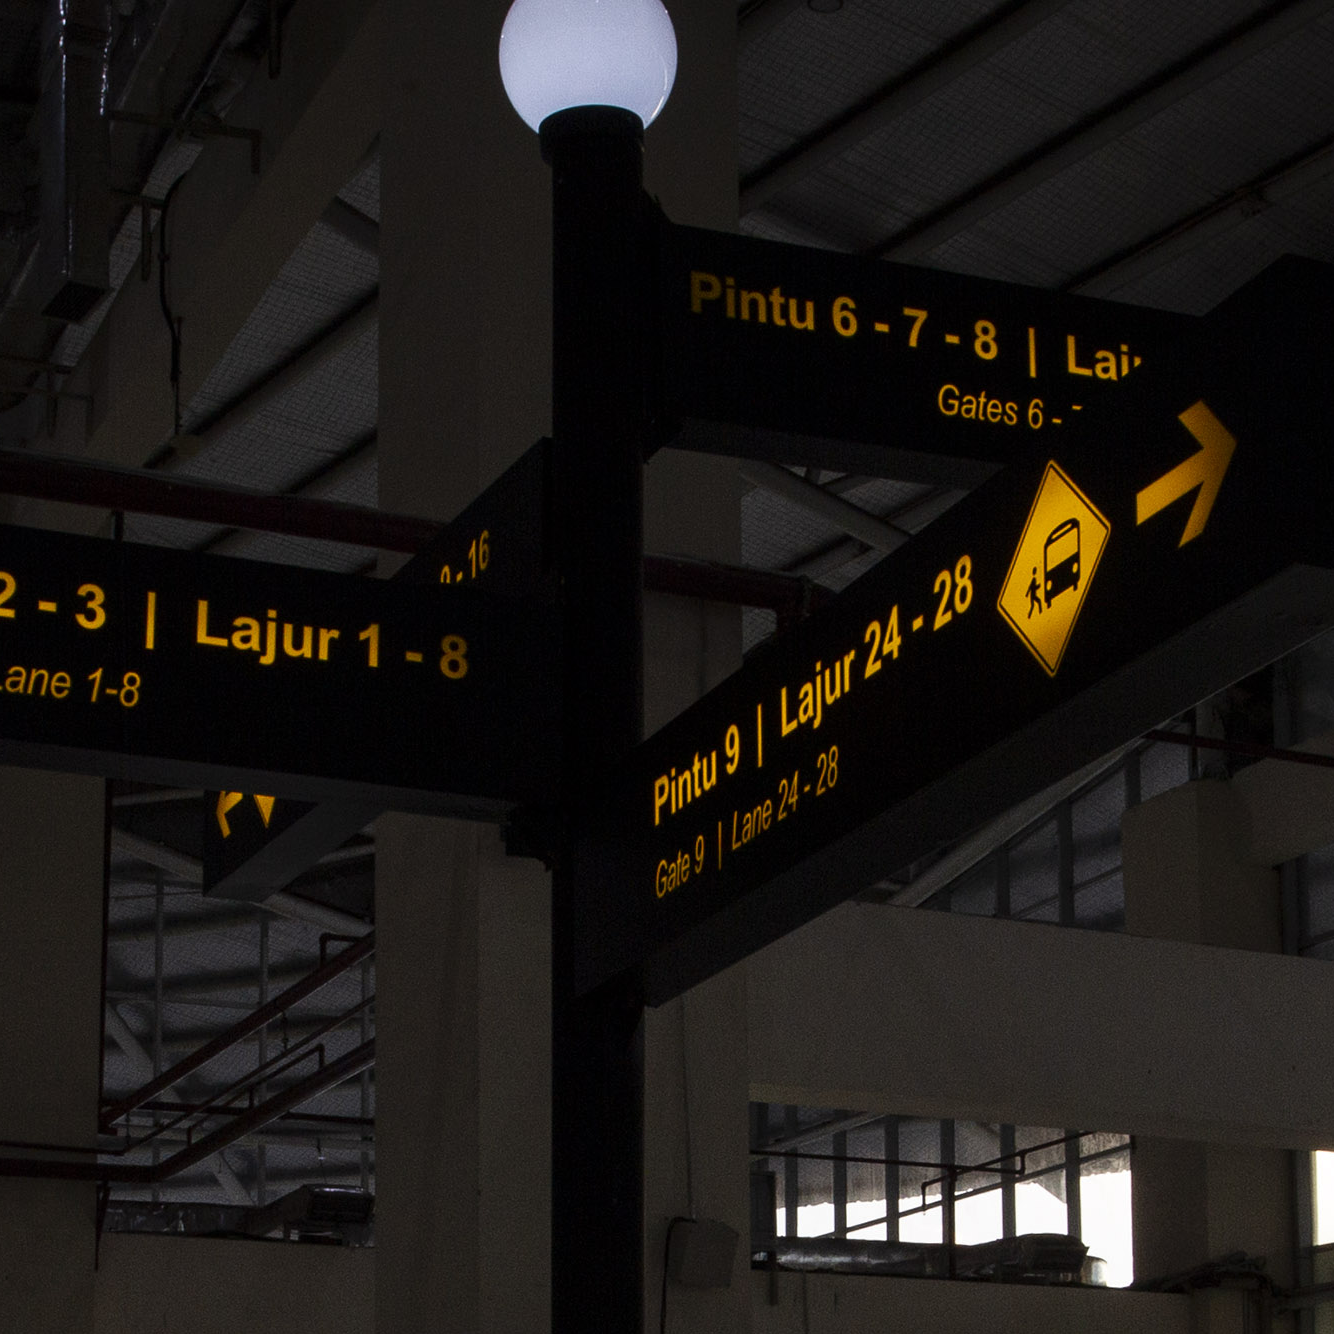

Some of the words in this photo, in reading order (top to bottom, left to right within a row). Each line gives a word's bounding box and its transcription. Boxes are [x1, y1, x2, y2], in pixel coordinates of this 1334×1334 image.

[689, 270, 815, 331] Pintu
[832, 296, 858, 337] 6
[903, 307, 928, 348] 7
[973, 319, 998, 361] 8
[937, 383, 1019, 426] Gates
[1027, 398, 1044, 430] 6
[468, 530, 489, 579] 16
[74, 583, 106, 630] 3
[196, 599, 340, 666] Lajur
[359, 623, 379, 668] 1
[440, 638, 468, 679] 8
[87, 667, 141, 707] 1-8
[654, 749, 717, 826] Pintu
[724, 723, 740, 775] 9
[780, 648, 856, 737] Lajur
[863, 604, 902, 680] 24
[932, 554, 974, 632] 28
[655, 850, 690, 898] Gate
[694, 834, 705, 874] 9
[731, 799, 773, 850] Lane
[777, 770, 799, 821] 24
[816, 744, 839, 796] 28
